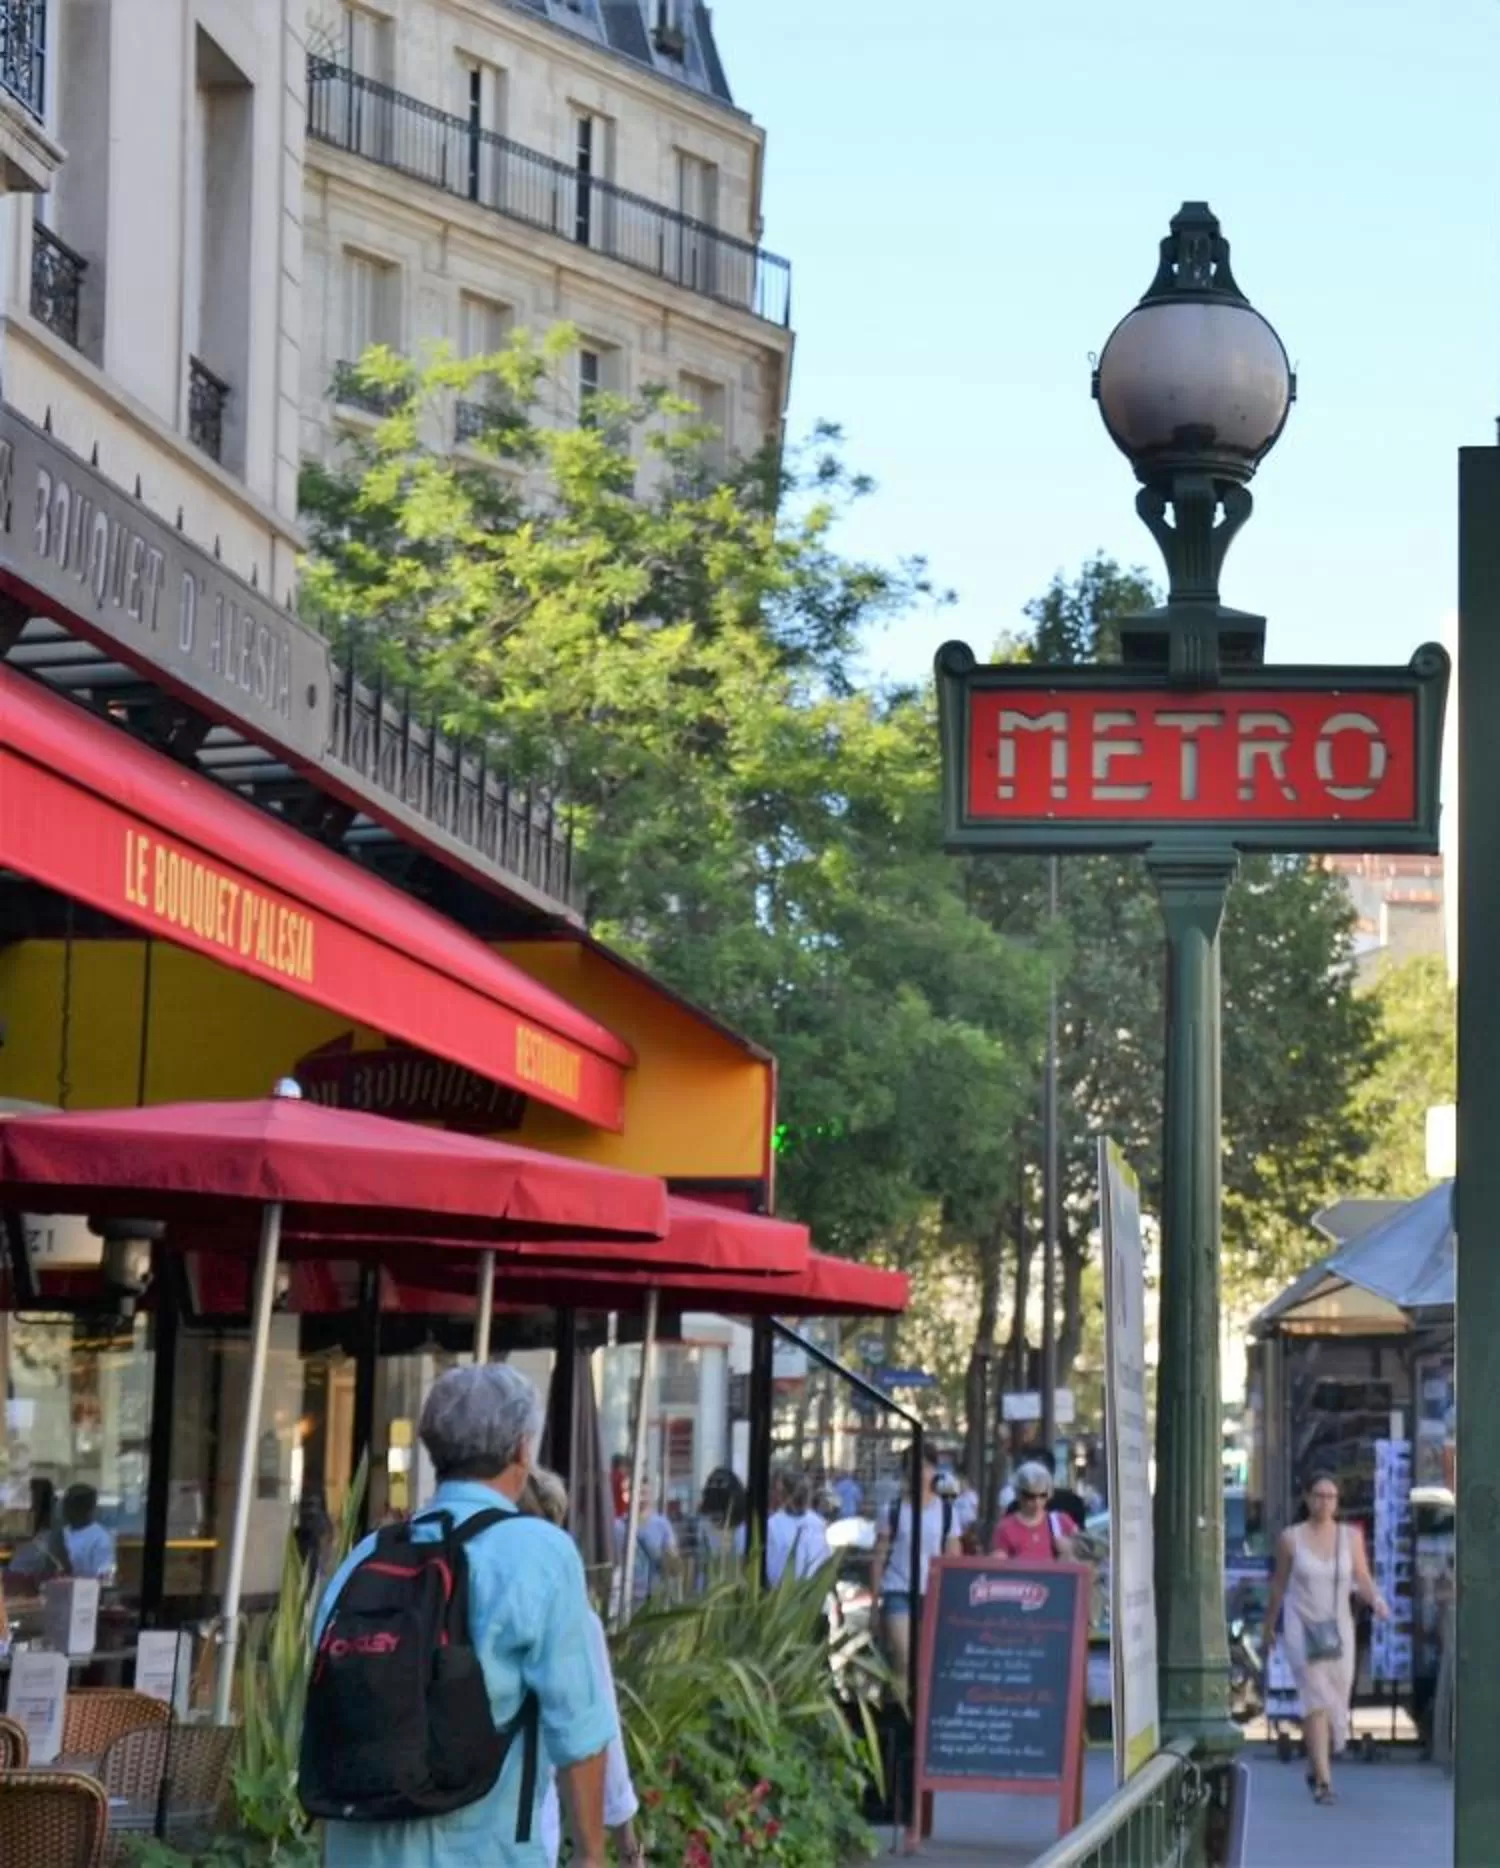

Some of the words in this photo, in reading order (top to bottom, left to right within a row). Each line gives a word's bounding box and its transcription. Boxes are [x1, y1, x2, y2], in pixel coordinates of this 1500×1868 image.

[34, 464, 165, 633] BOUQUET
[997, 708, 1387, 802] METRO
[125, 829, 150, 908] LE
[154, 844, 241, 948] BOUQUET
[239, 887, 315, 984] D'ALESIA
